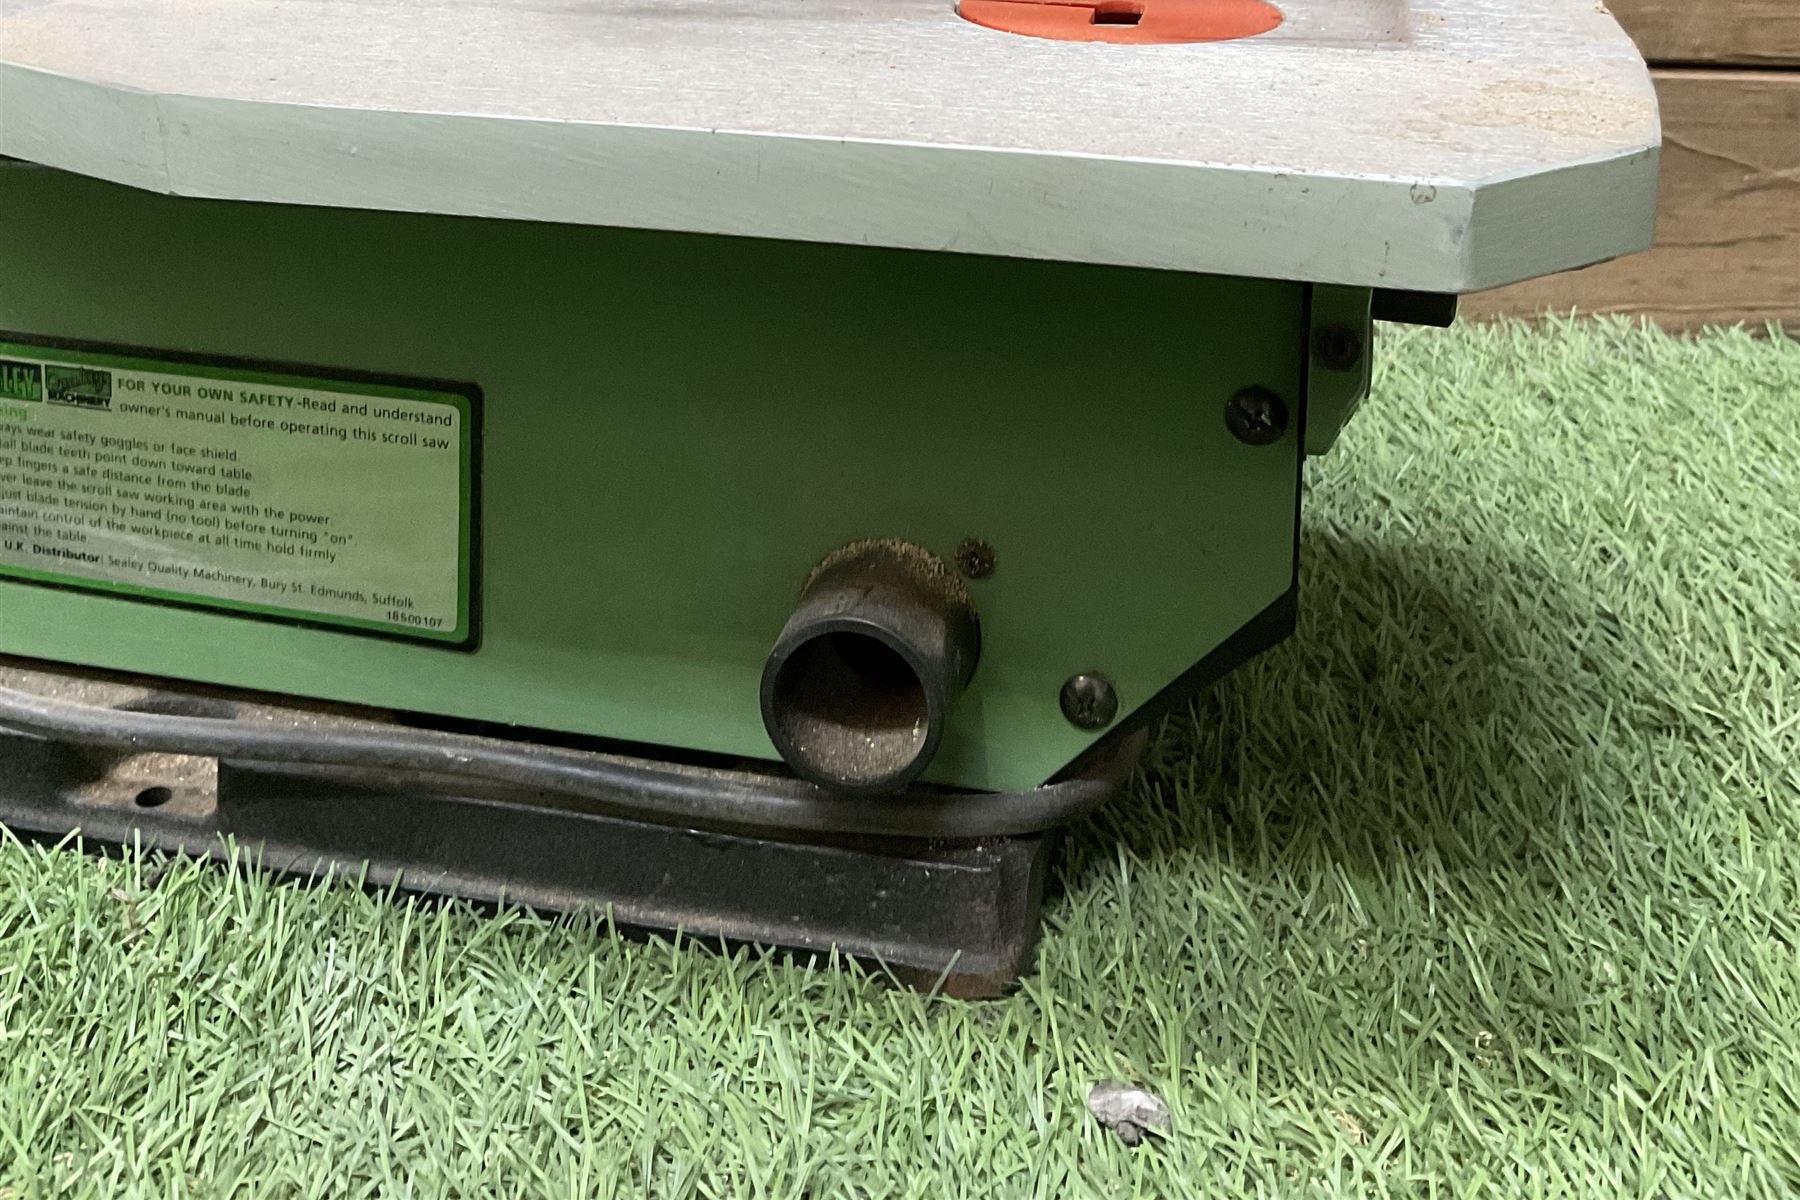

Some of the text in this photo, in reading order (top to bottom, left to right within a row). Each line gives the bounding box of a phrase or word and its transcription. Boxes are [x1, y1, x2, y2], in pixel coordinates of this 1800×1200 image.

[117, 378, 145, 392] FOR
[152, 382, 191, 397] YOUR
[197, 387, 234, 402] OWN
[239, 391, 294, 409] SAFETY
[341, 404, 368, 416] and
[373, 407, 452, 427] understand
[119, 402, 450, 450] owner's manual before operating this scroll saw
[21, 440, 54, 456] blade
[59, 446, 91, 460] teeth
[95, 451, 127, 464] point
[132, 455, 167, 469] down
[171, 461, 216, 477] toward
[26, 426, 55, 438] wear
[60, 430, 96, 446] safety
[101, 437, 149, 452] goggles
[153, 442, 165, 453] or
[171, 442, 197, 456] face
[18, 455, 58, 473] fingers
[62, 464, 69, 473] a
[73, 465, 98, 478] safe
[102, 468, 152, 485] distance
[157, 474, 187, 489] from
[191, 480, 212, 493] the
[22, 473, 53, 488] leave
[58, 479, 77, 491] the
[82, 484, 112, 496] scroll
[116, 488, 140, 500] saw
[143, 492, 195, 510] working
[199, 500, 227, 512] area
[231, 503, 259, 517] with
[264, 506, 285, 520] the
[26, 489, 60, 505] blade
[64, 497, 108, 513] tension
[112, 503, 127, 518] by
[130, 505, 161, 520] hand
[166, 509, 187, 524] (no
[191, 514, 221, 529] tool)
[224, 517, 267, 535] before
[270, 524, 318, 544] turning
[33, 524, 53, 537] the
[42, 512, 85, 526] control
[88, 515, 101, 529] of
[106, 519, 126, 532] the
[130, 524, 194, 541] workpiece
[198, 533, 210, 545] at
[215, 534, 230, 548] all
[234, 537, 262, 552] time
[266, 540, 295, 556] hold
[299, 546, 337, 564] firmly
[108, 554, 144, 572] Sealey
[147, 561, 189, 579] Quality
[193, 567, 256, 588] Machinery,
[260, 577, 288, 594] Bury
[310, 584, 368, 604] Edmunds,
[372, 592, 415, 609] Suffolk
